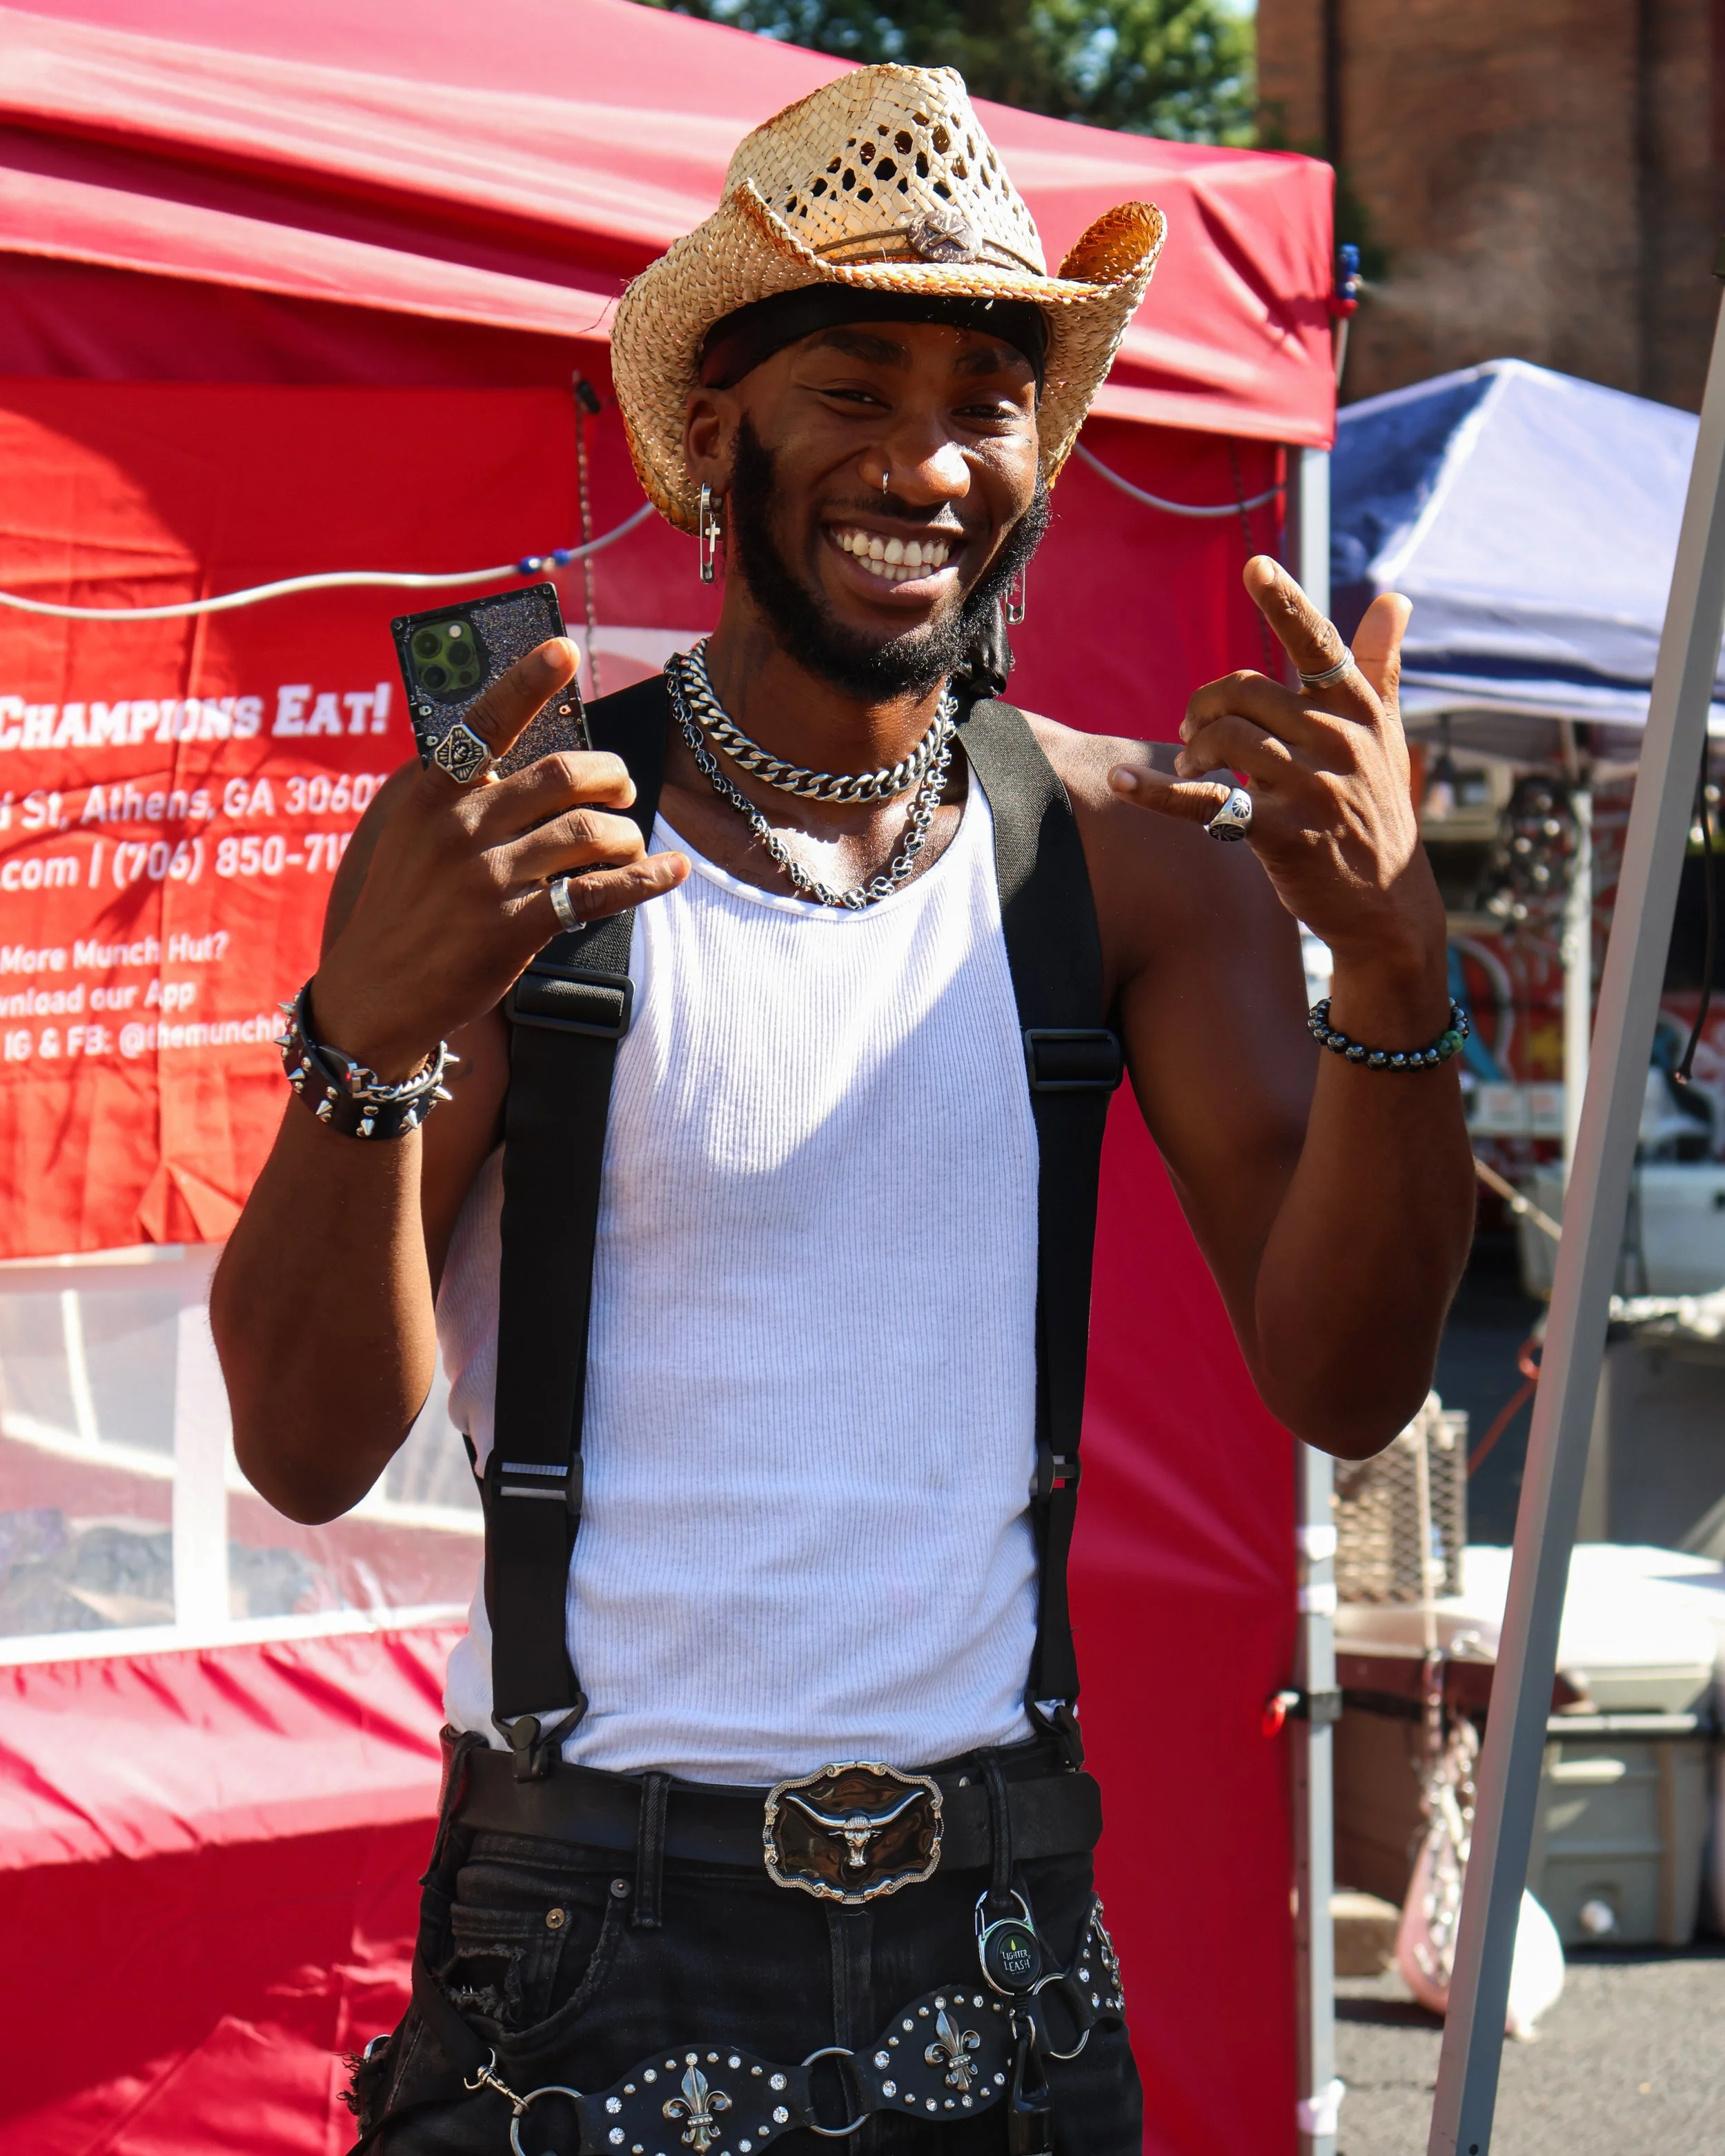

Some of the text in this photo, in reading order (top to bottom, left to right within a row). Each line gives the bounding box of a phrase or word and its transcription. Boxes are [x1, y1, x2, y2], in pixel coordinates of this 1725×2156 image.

[20, 789, 69, 832] St,
[79, 783, 216, 825] Athens,
[223, 777, 275, 819] GA
[112, 836, 205, 890] (706)
[0, 930, 230, 976] More Munch Hut?
[90, 987, 139, 1012] our
[143, 978, 197, 1012] App
[3, 1028, 32, 1062] IG
[39, 1026, 61, 1060] &
[67, 1023, 112, 1057] FB:
[1003, 1950, 1027, 1960] LIGHTER
[1004, 1959, 1029, 1971] LEASH
